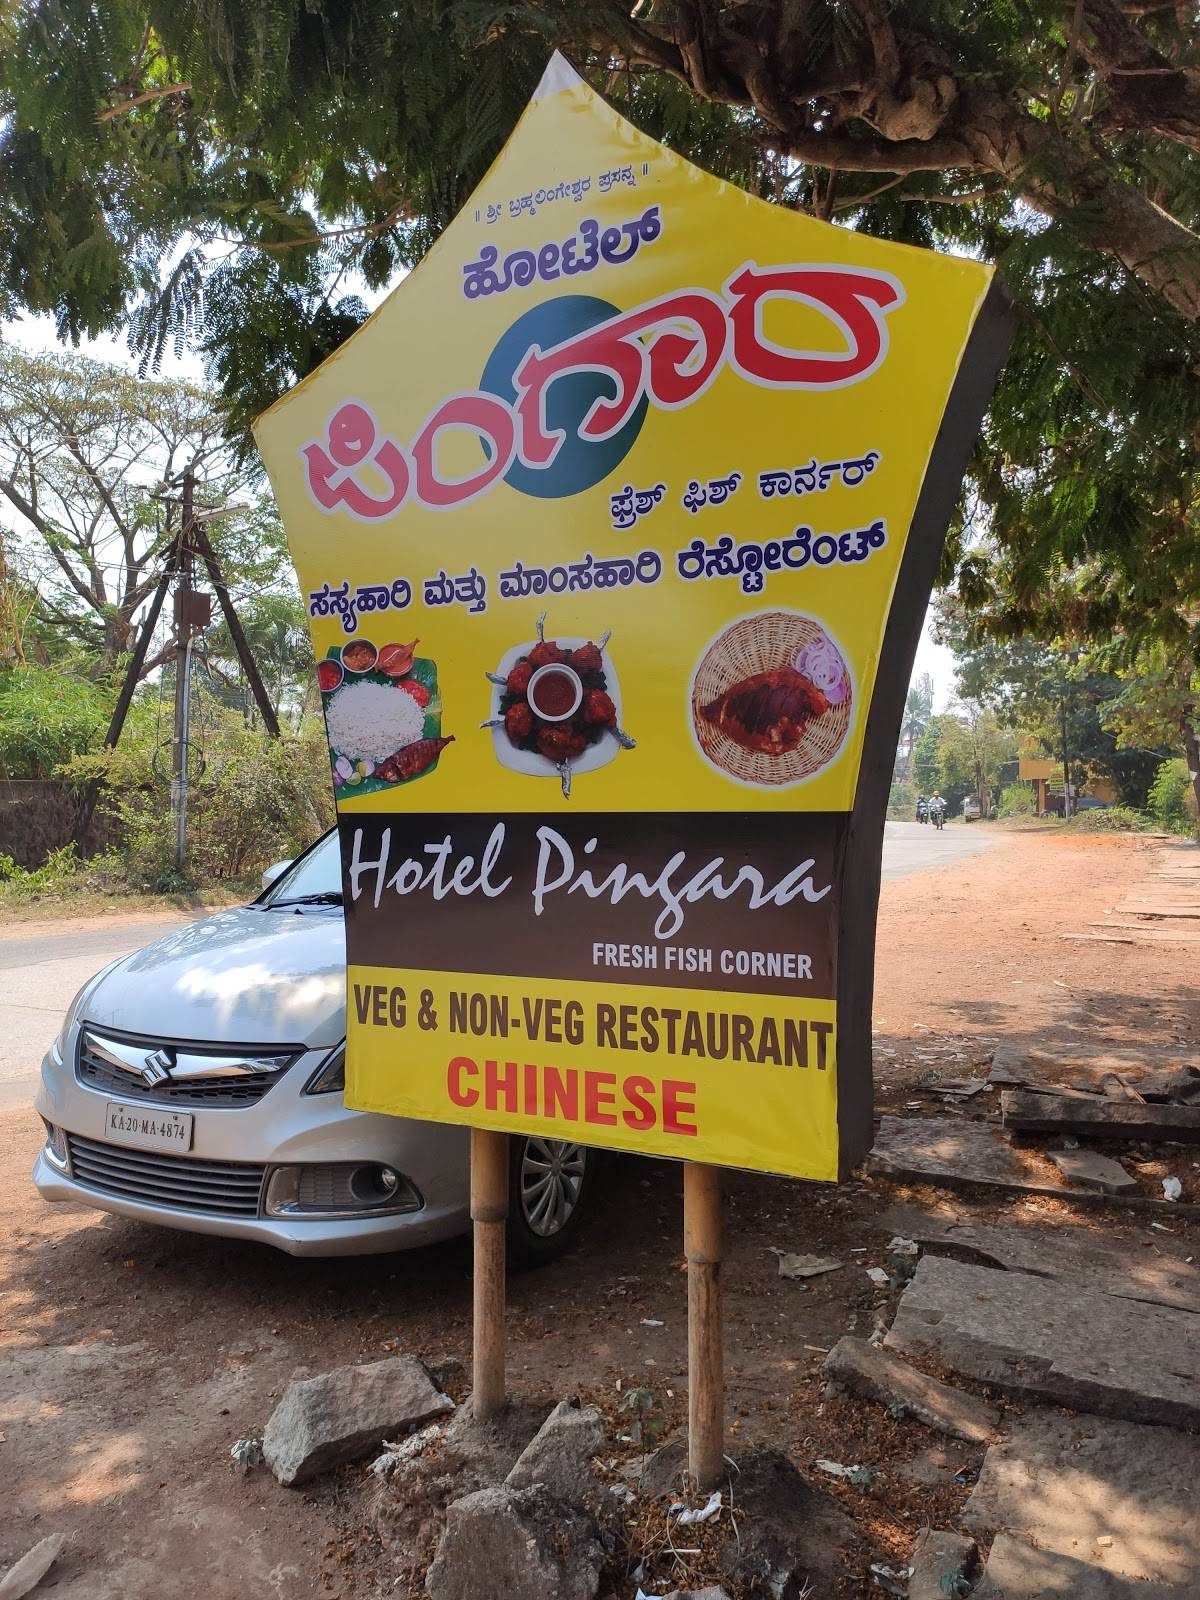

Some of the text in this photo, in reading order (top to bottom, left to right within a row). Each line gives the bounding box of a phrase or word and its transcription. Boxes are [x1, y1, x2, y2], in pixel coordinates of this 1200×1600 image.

[486, 204, 502, 225] ಶ್ರೀ
[509, 176, 591, 218] ಬ್ರಹ್ಮಲಿಂಗೇಶ್ವರ
[599, 165, 636, 193] ಪ್ರಸನ್ನ
[463, 206, 661, 299] ಹೋಟೆಲ್
[302, 264, 902, 521] ಪಿಂಗಾರ
[610, 452, 880, 529] ಫ್ರೆಶ್ ಫಿಶ್ ಕಾರ್ನರ್
[309, 521, 886, 634] ಸಸ್ಯಹಾರಿ ಮತ್ತು ಮಾಂಸಹಾರಿ ರೆಸ್ಟೋರೆಂಟ್
[349, 821, 832, 941] Hotel Pingara
[592, 942, 813, 980] FRESH FISH CORNER
[353, 984, 834, 1071] VEG & NON-VEG RESTAURANT
[446, 1055, 698, 1137] CHINESE
